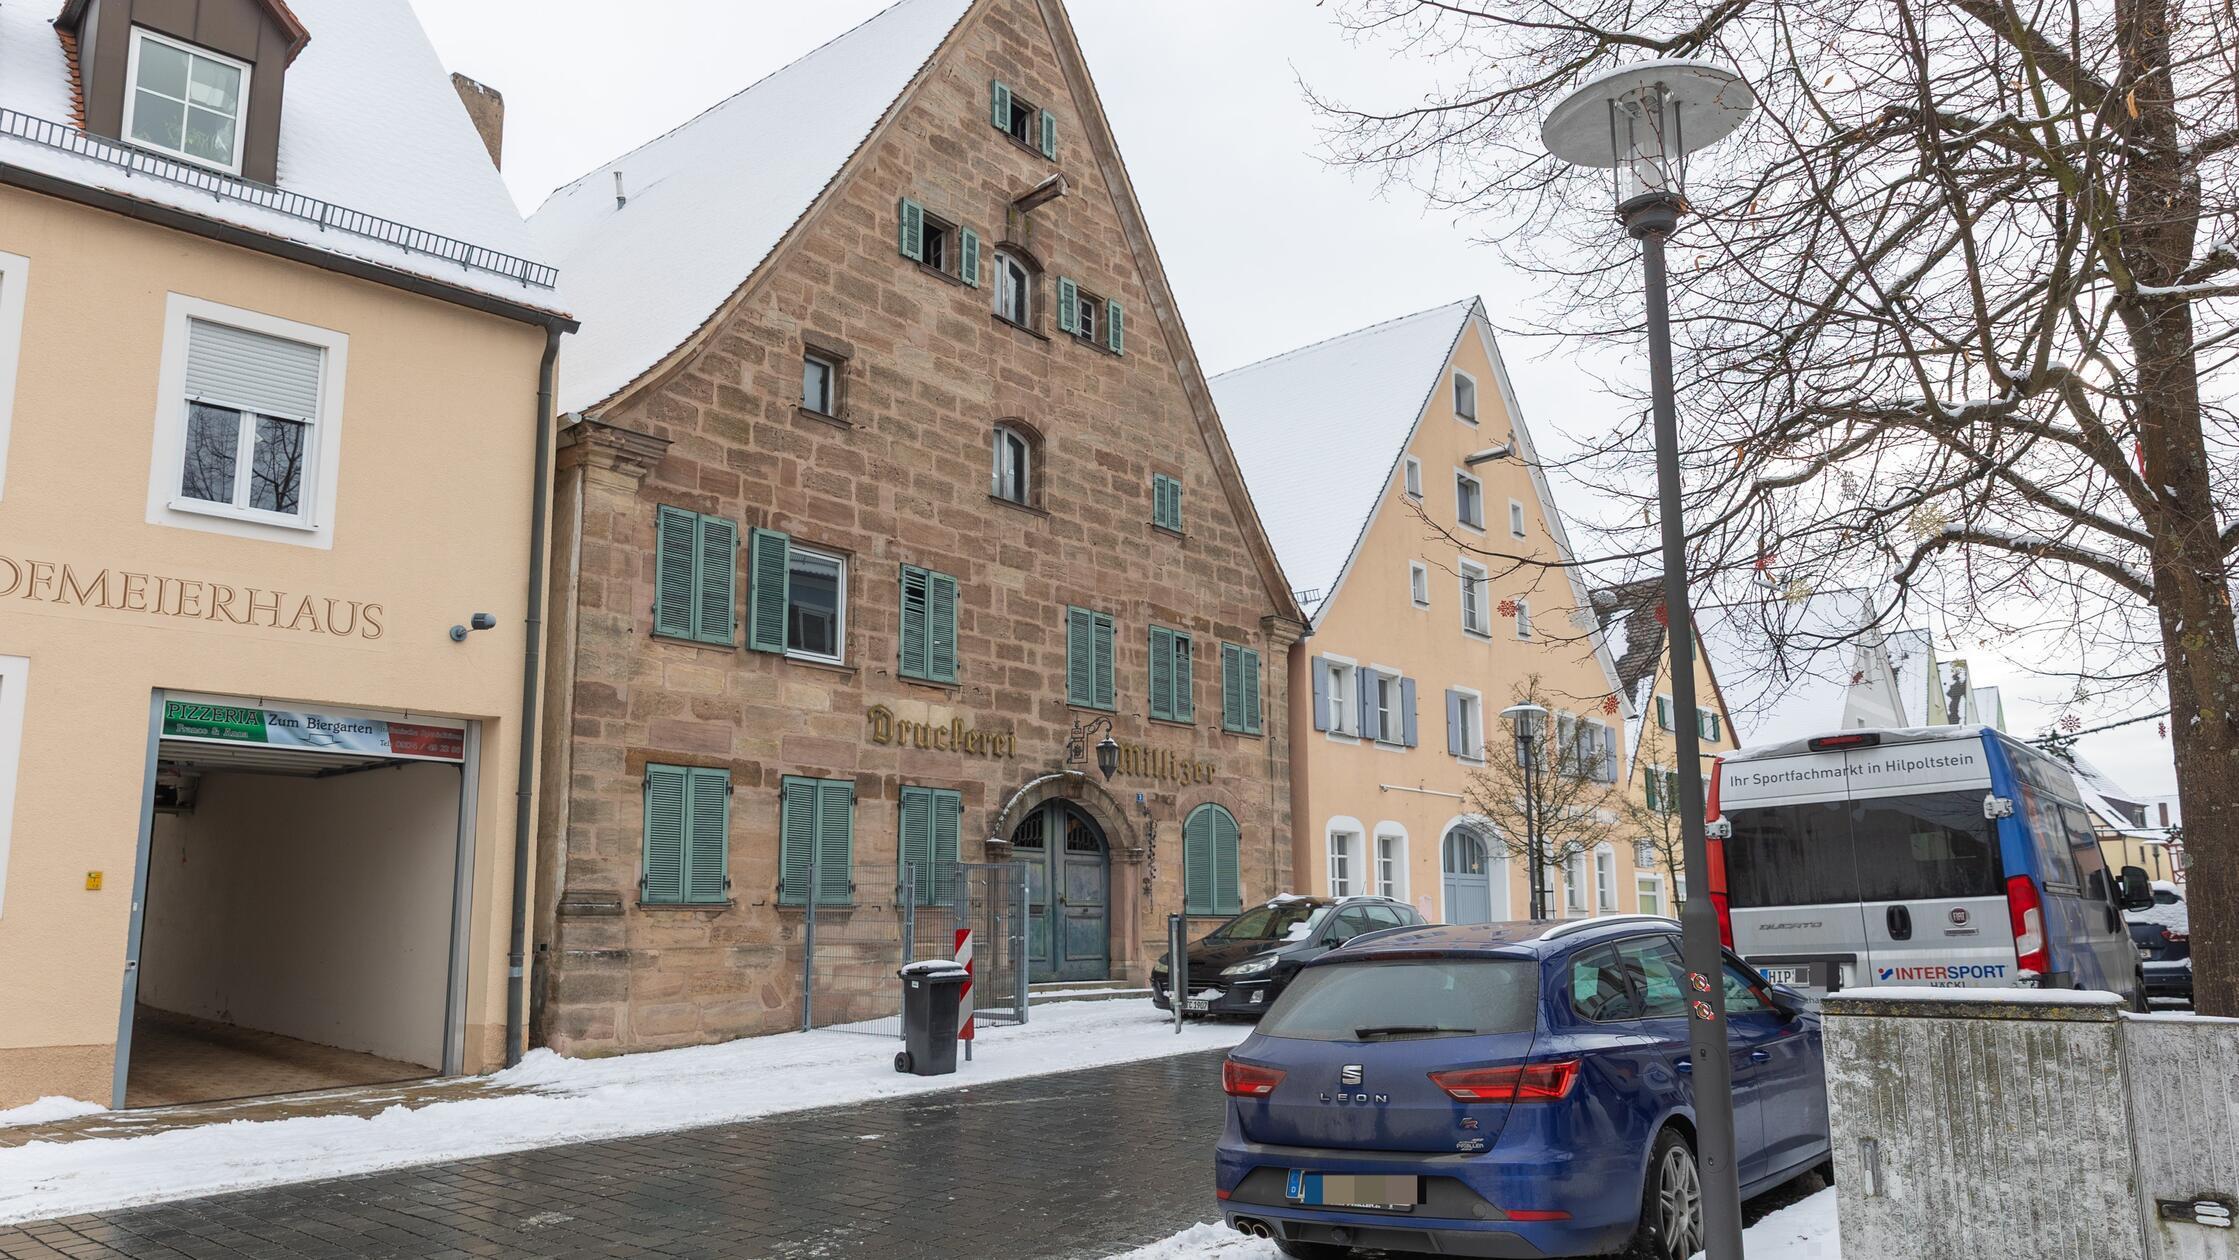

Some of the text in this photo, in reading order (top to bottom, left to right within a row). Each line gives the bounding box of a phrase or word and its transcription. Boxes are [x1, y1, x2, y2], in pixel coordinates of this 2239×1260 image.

[168, 703, 259, 726] PIZZERIA
[268, 713, 299, 728] Zum
[306, 717, 373, 734] Biergarten
[867, 703, 1018, 758] Druckerei
[1730, 753, 1974, 787] Ihr Sportfachmarkt in Hilpoltstein
[1769, 970, 1791, 983] HIP
[1895, 965, 2006, 980] INTERSPORT
[1320, 1093, 1387, 1103] LEON
